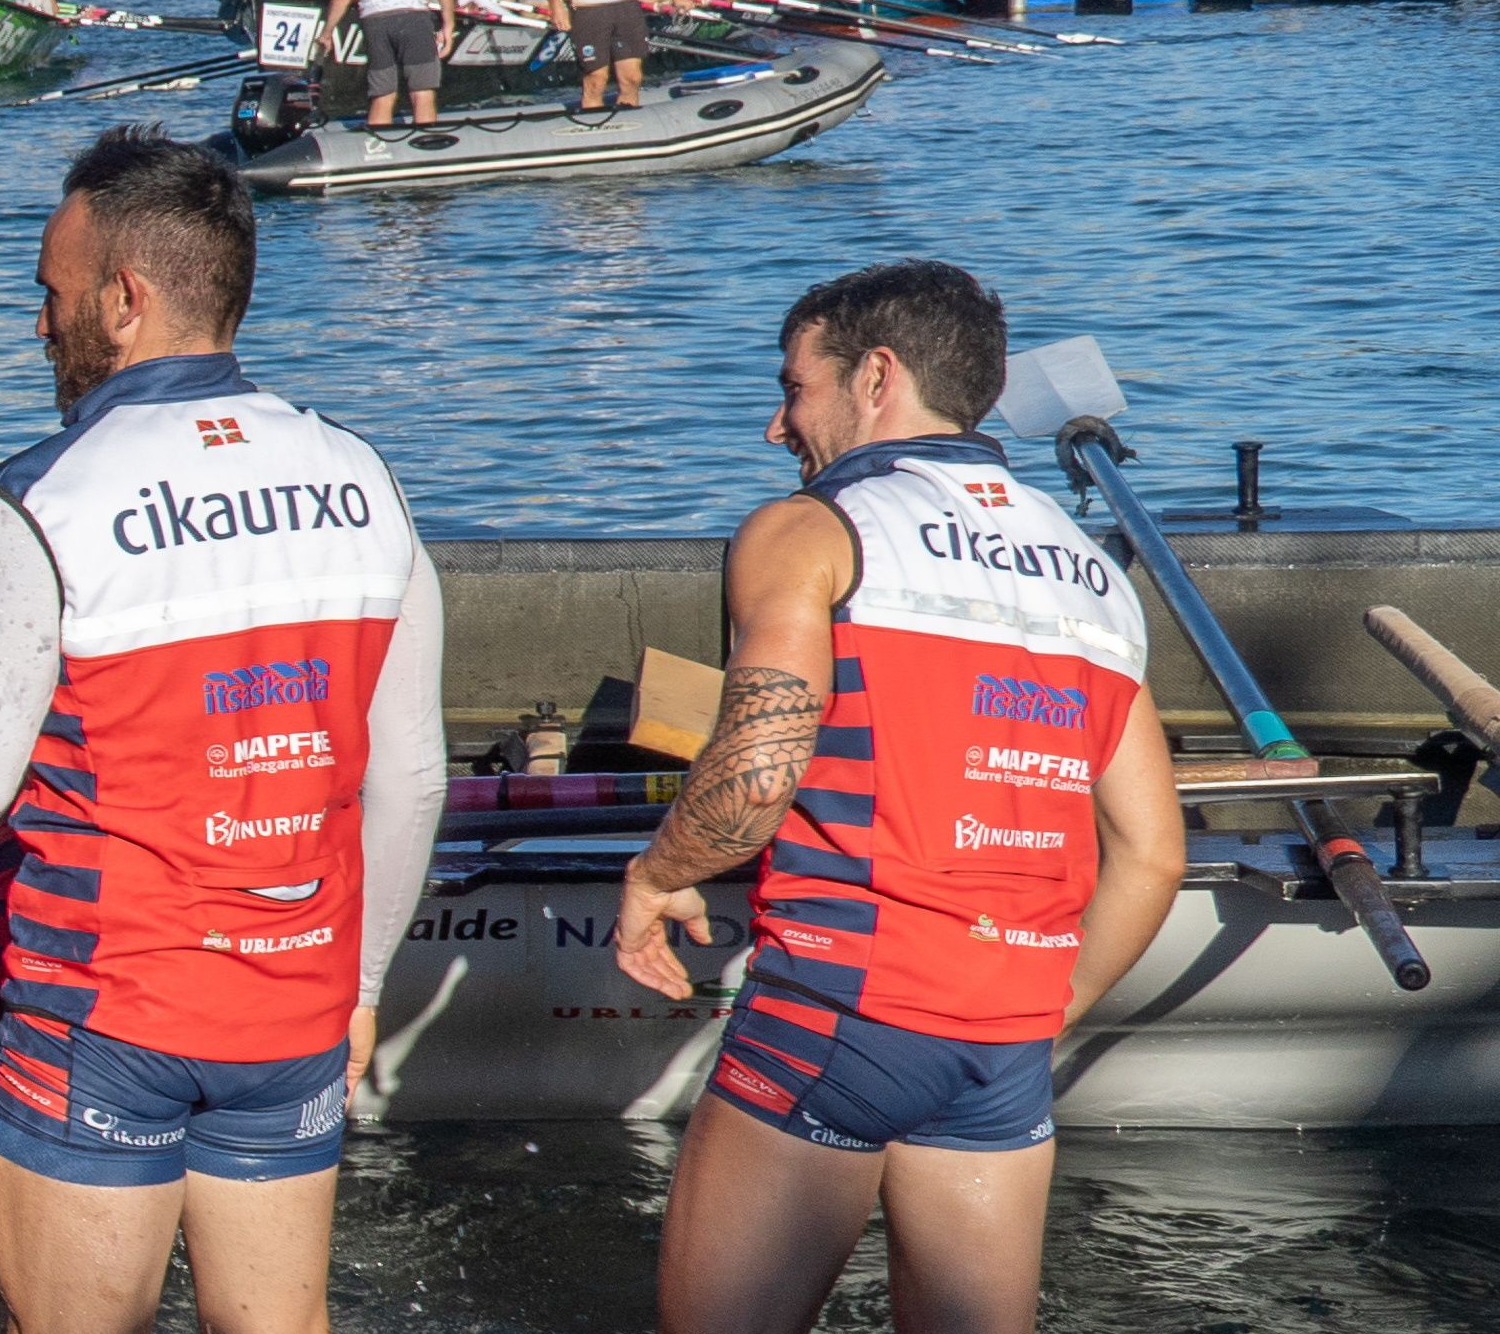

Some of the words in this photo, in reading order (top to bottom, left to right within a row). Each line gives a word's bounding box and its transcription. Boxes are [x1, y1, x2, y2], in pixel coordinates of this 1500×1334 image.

[274, 21, 301, 52] 24
[964, 768, 1002, 782] Idurre
[784, 928, 833, 945] DYALVO
